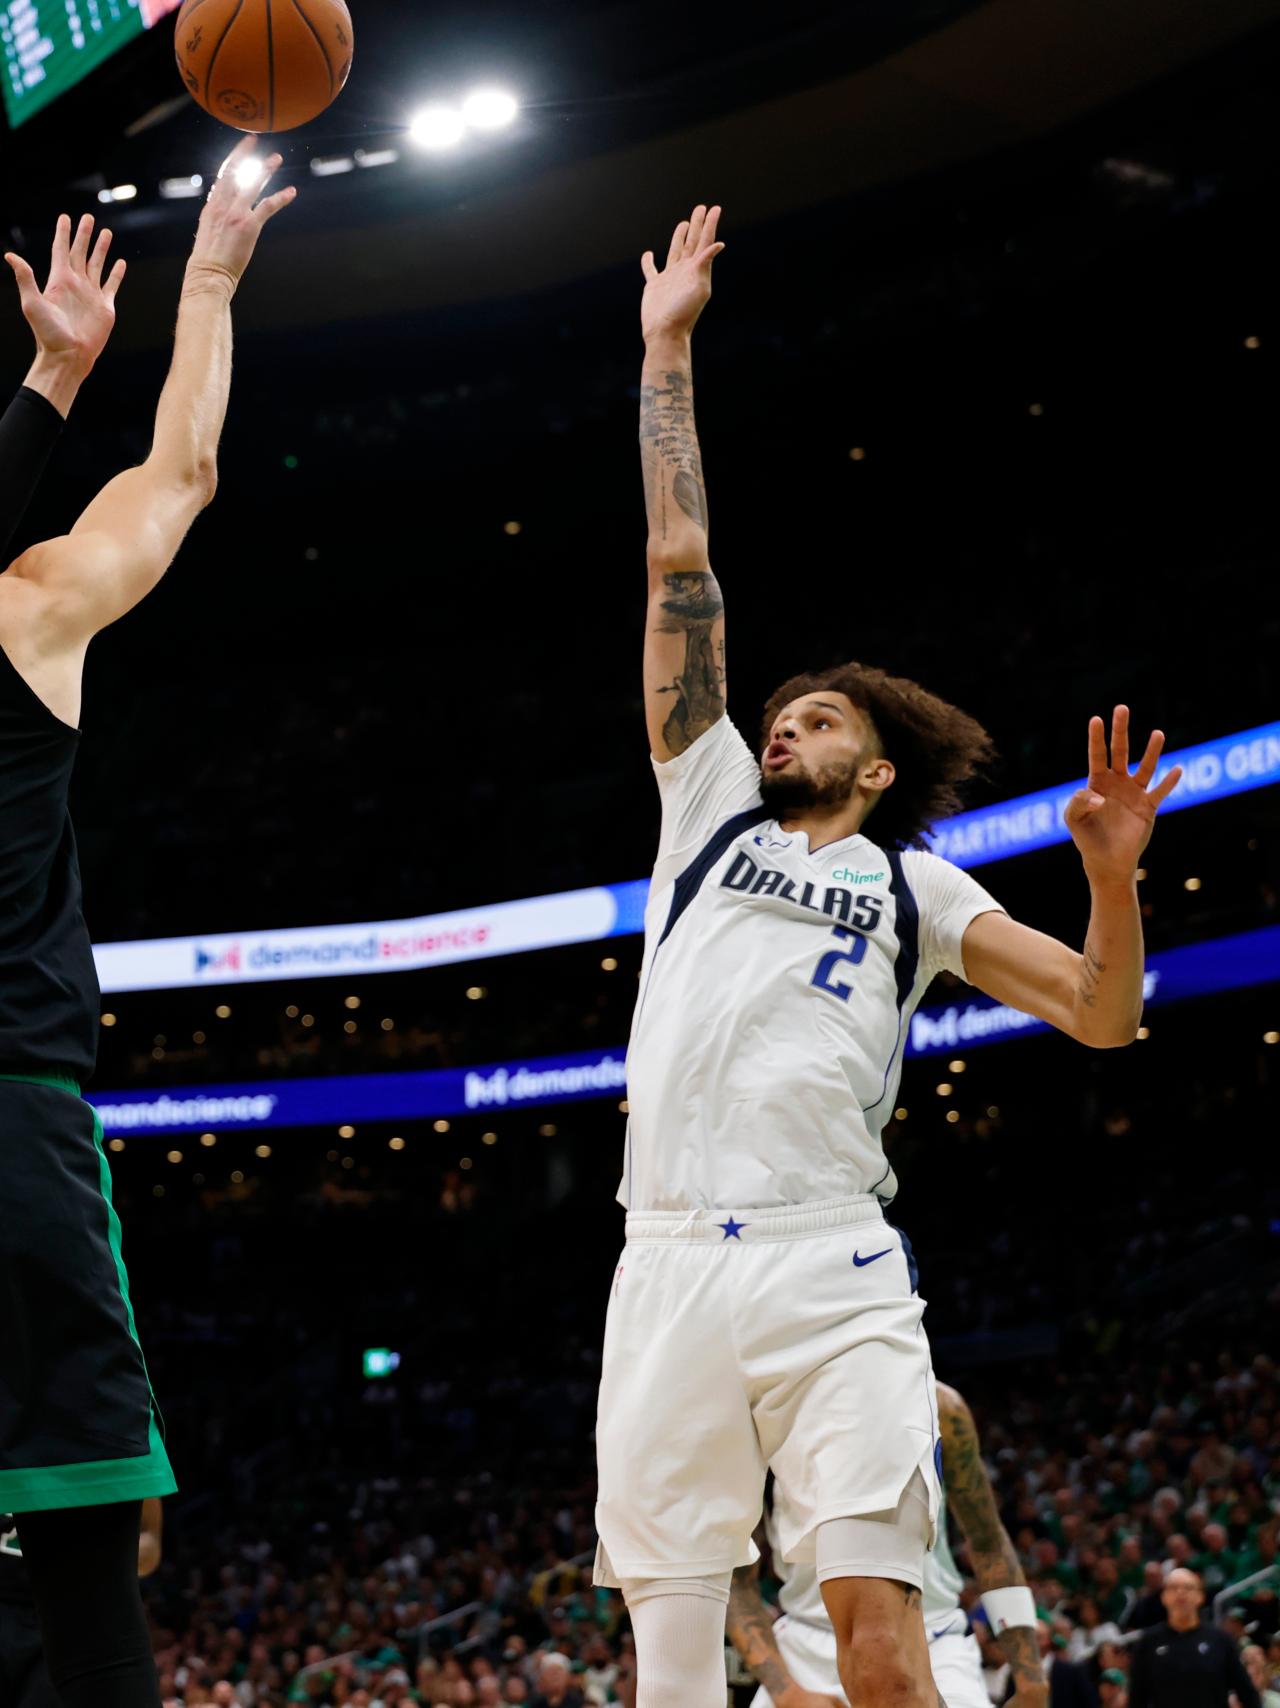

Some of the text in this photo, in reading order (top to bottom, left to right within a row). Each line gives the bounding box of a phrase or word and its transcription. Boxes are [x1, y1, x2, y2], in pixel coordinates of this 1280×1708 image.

[720, 849, 883, 934] DALLAS
[832, 867, 885, 885] chime
[810, 924, 869, 1002] 2
